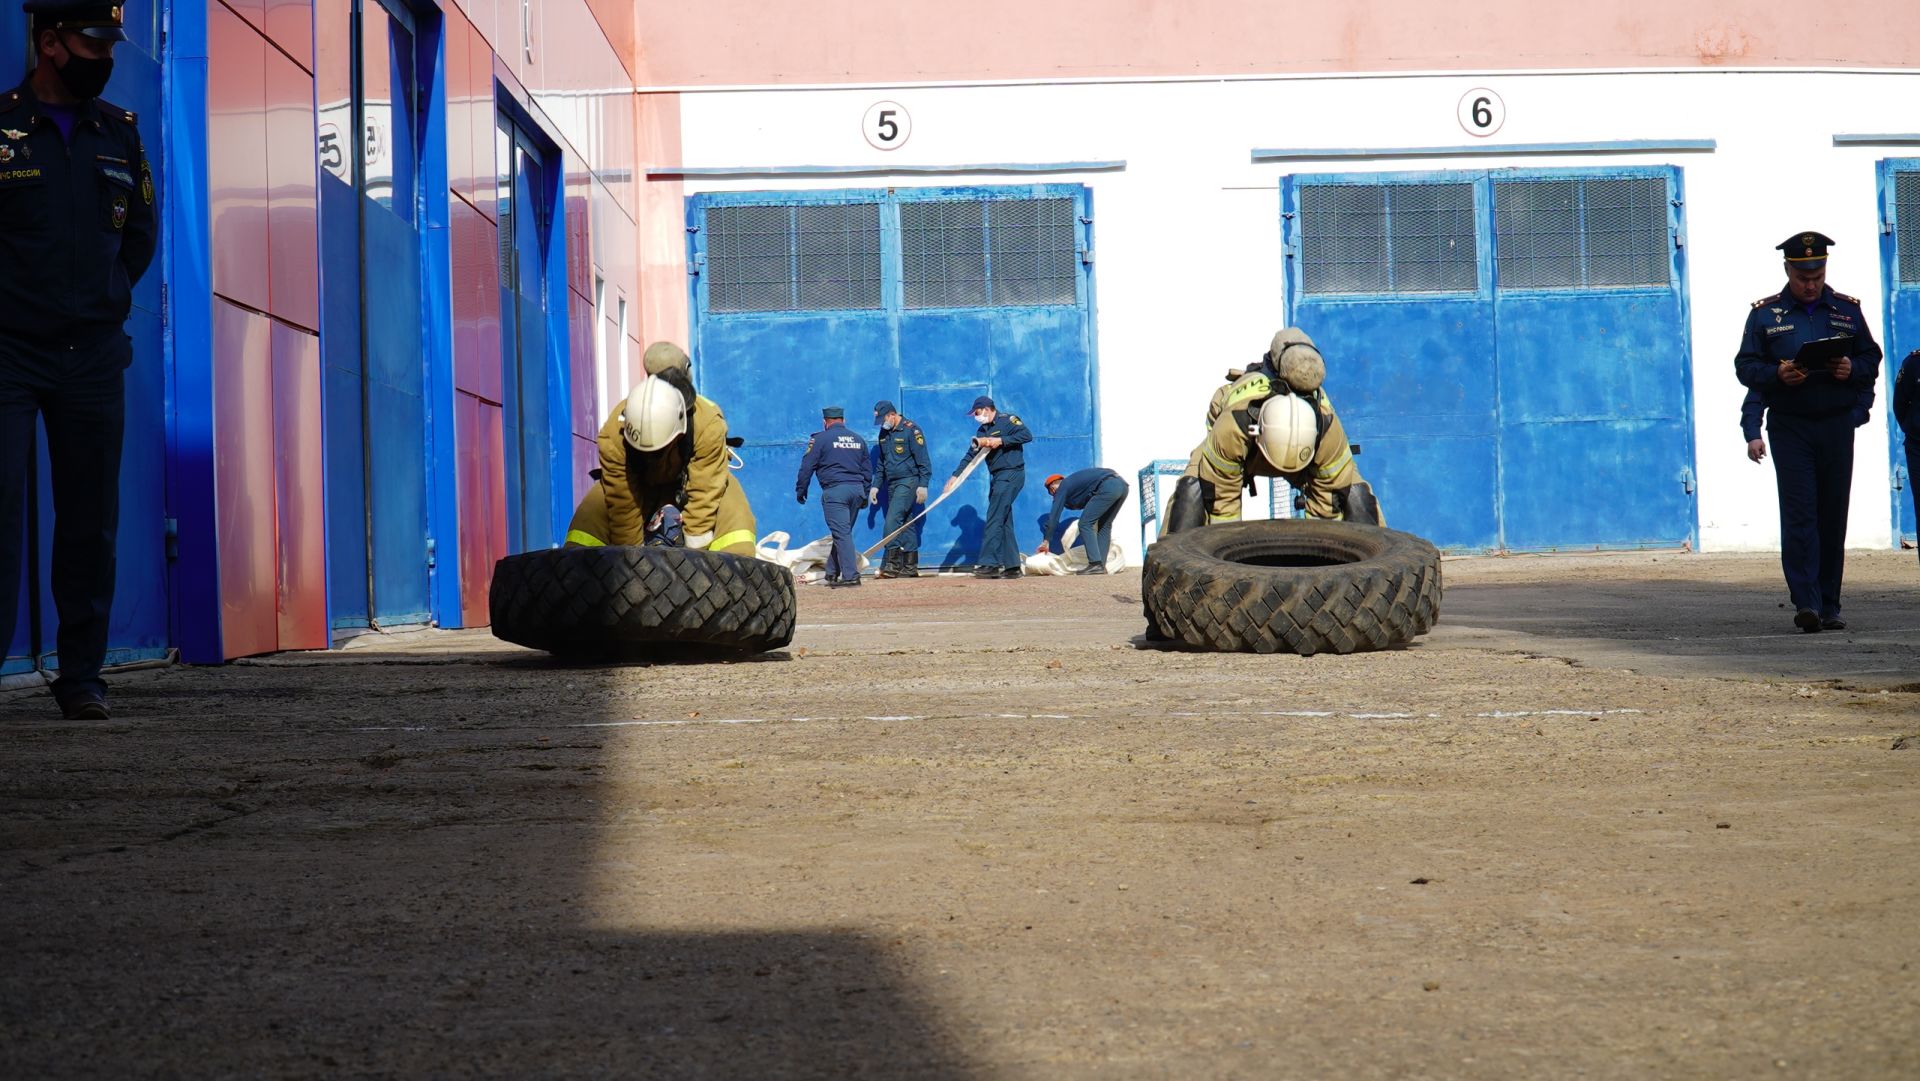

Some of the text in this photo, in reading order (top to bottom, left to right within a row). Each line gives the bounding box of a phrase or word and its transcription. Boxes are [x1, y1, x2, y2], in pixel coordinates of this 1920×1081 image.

[878, 110, 898, 141] 5
[1472, 97, 1492, 128] 6
[12, 169, 40, 178] РОССИИ
